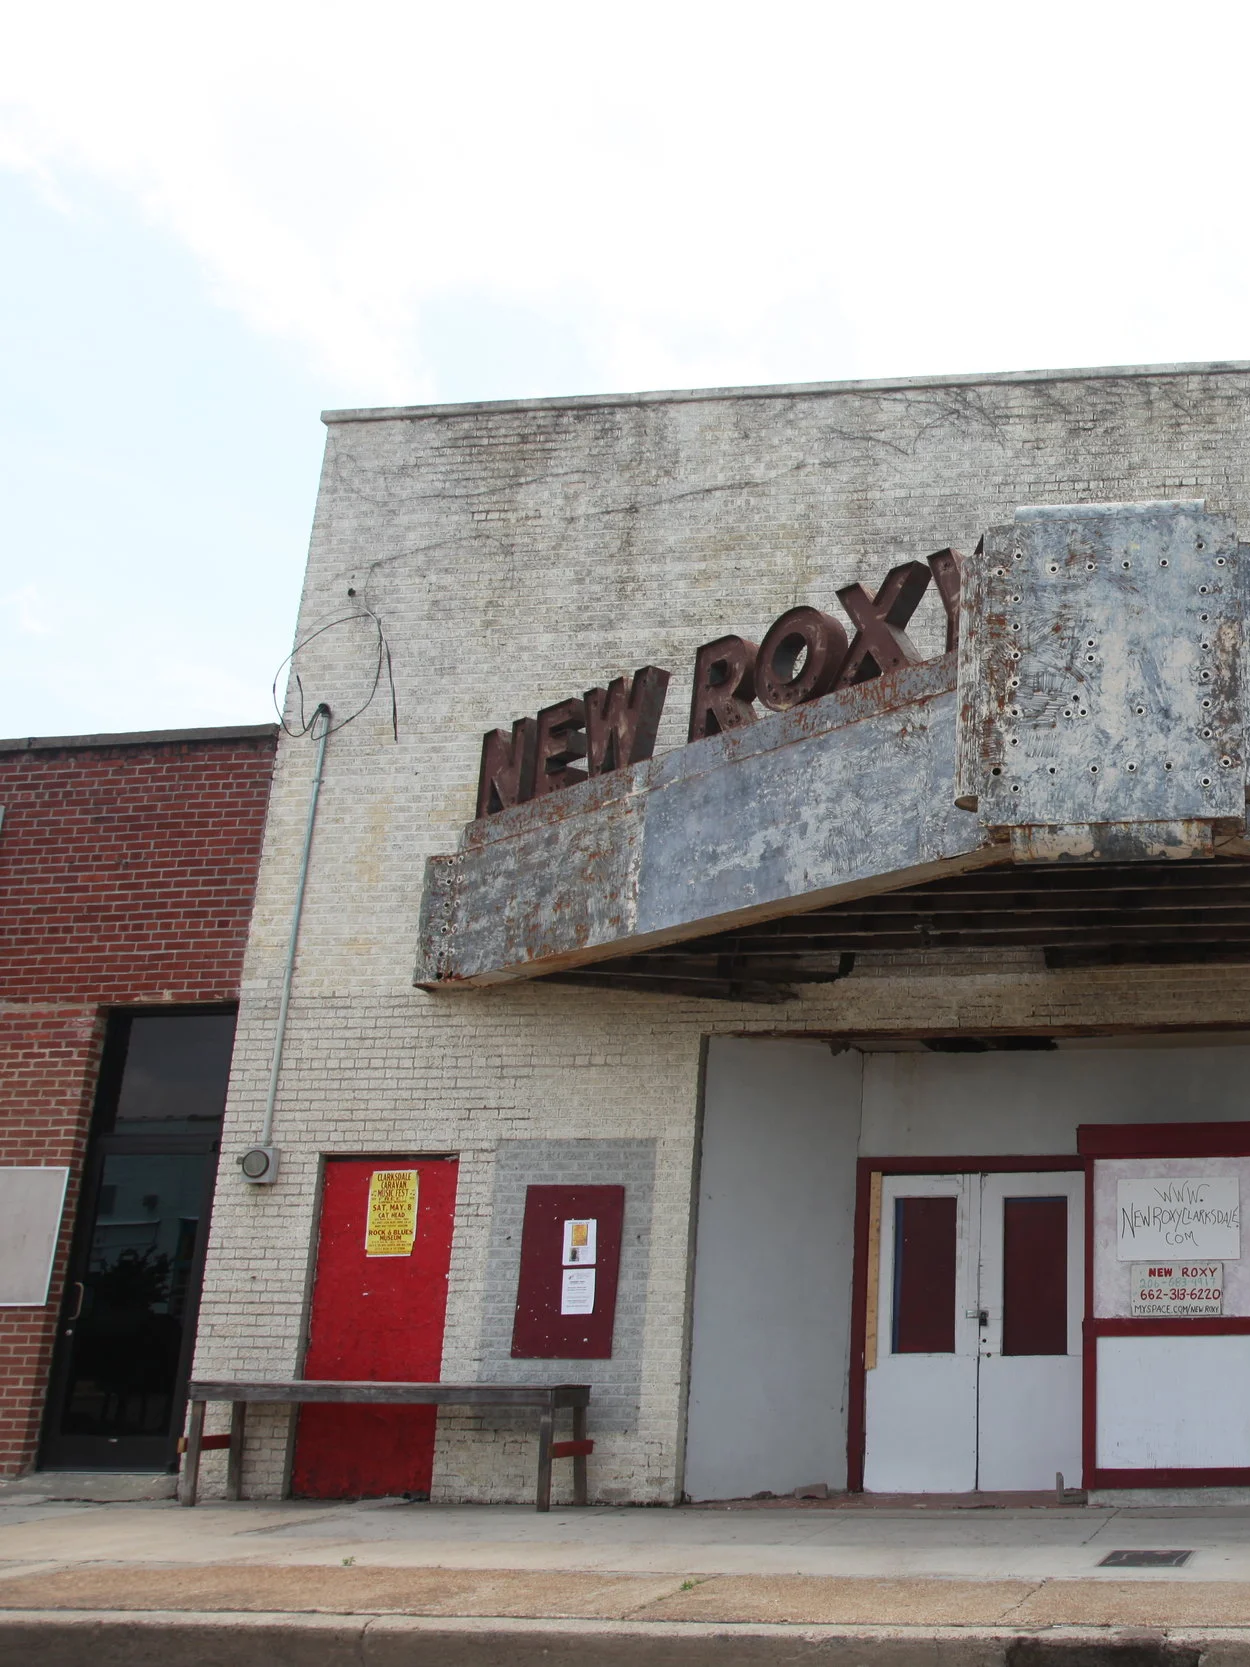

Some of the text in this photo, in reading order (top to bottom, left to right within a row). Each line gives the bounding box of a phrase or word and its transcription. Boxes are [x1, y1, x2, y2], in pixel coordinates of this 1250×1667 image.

[475, 665, 671, 819] NEW
[377, 1172, 412, 1181] CLARKSDALE
[381, 1180, 407, 1189] CARAVAN
[377, 1188, 408, 1197] MUSIC FEST
[1165, 1230, 1199, 1247] COM
[1148, 1267, 1218, 1278] NEW ROXY
[1140, 1288, 1221, 1300] 662-313-6220
